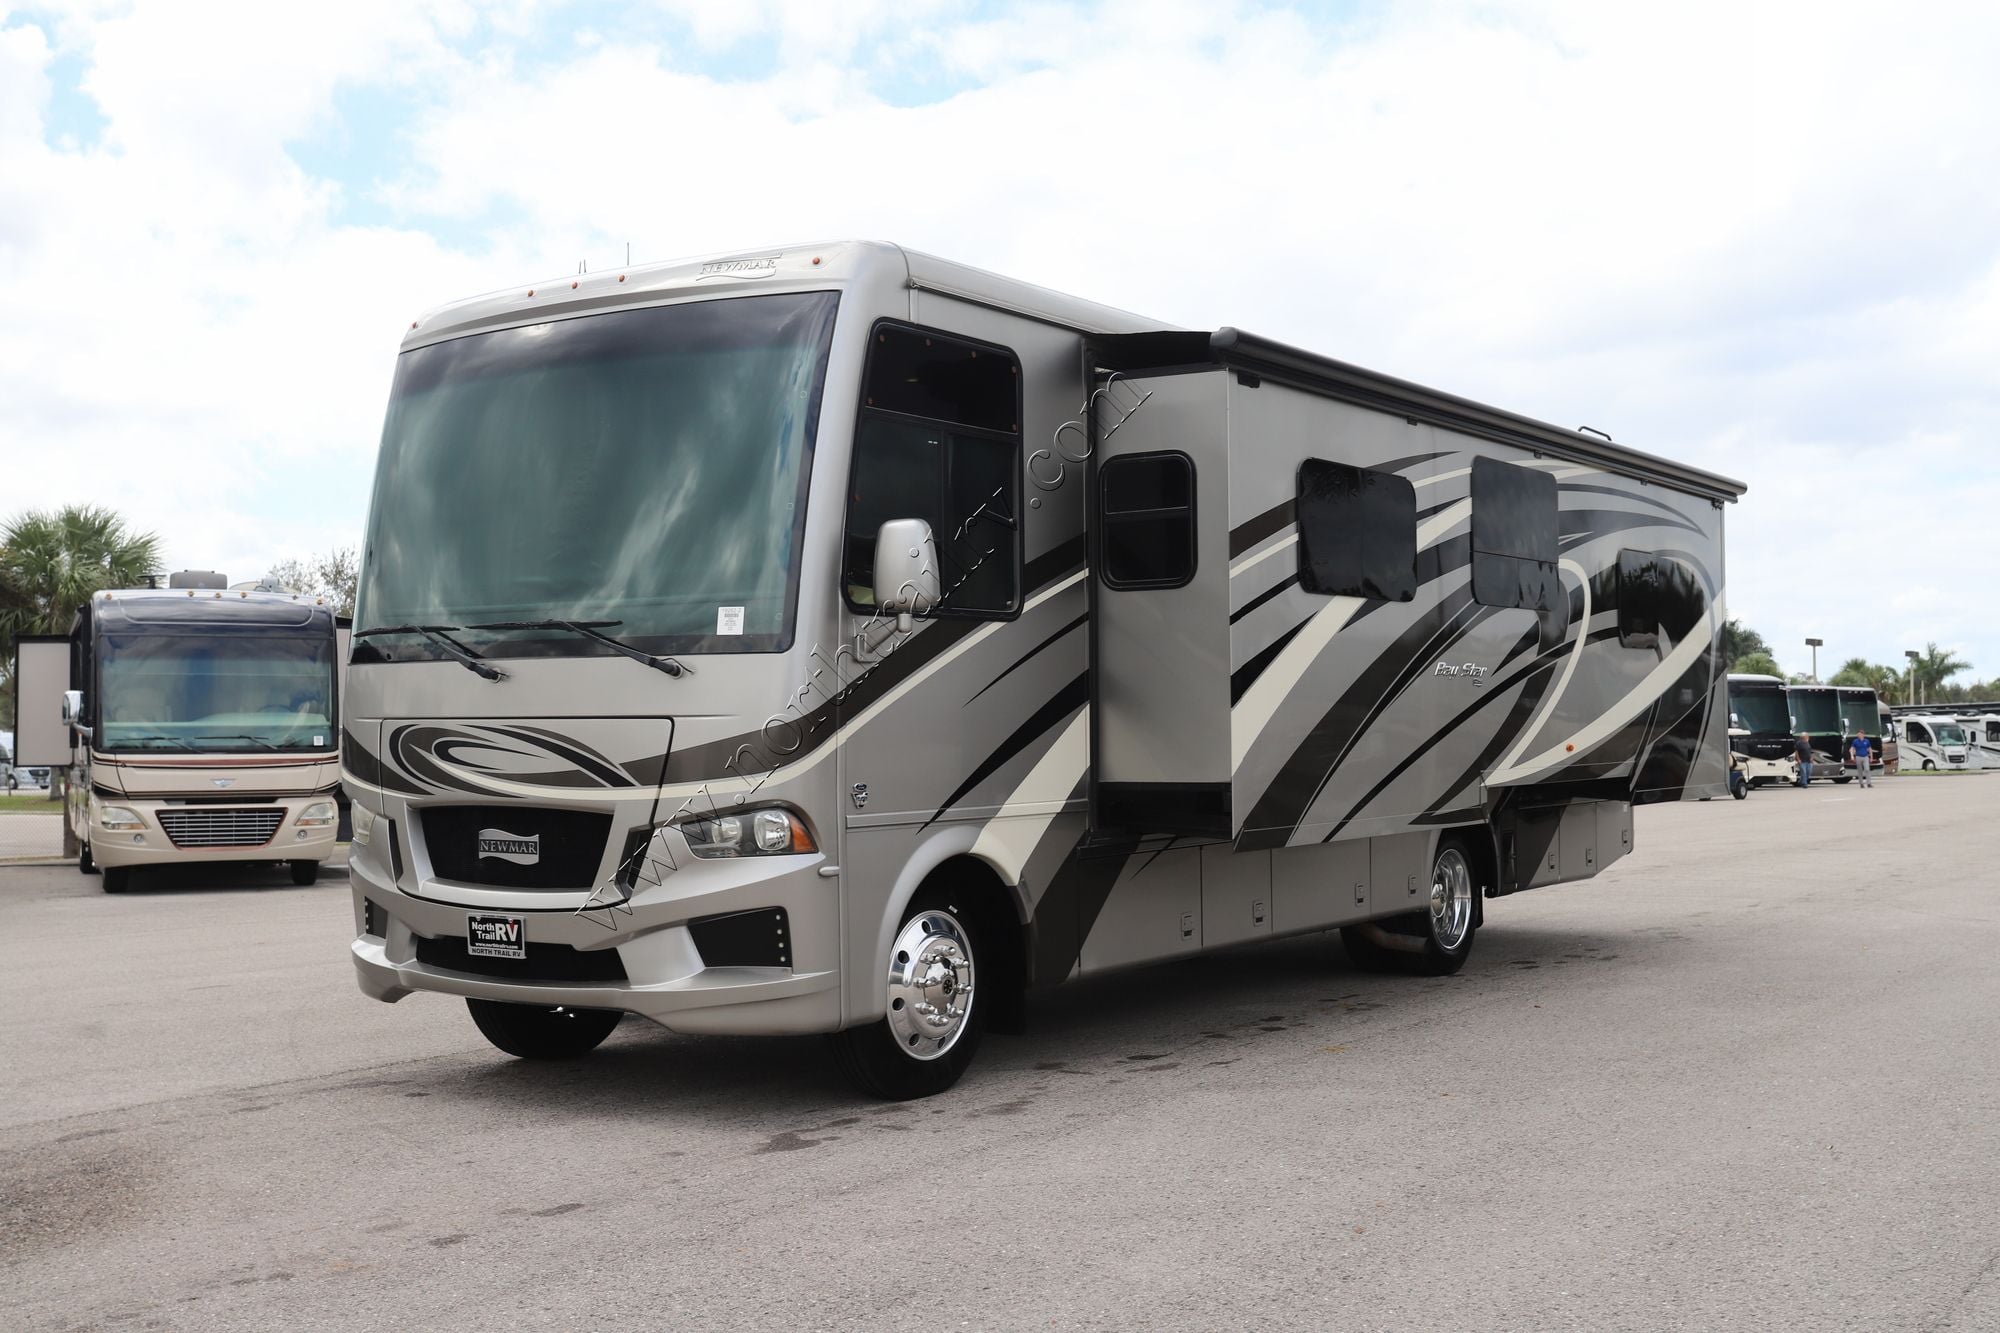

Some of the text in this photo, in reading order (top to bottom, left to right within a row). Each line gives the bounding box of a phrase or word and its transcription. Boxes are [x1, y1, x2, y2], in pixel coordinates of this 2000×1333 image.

[700, 259, 777, 275] NEWMAR
[1460, 662, 1488, 677] Star
[480, 840, 537, 853] NEWMAR
[471, 921, 519, 942] North RV
[476, 930, 496, 940] Trail
[471, 947, 493, 956] NORTH
[494, 949, 512, 957] TRAIL
